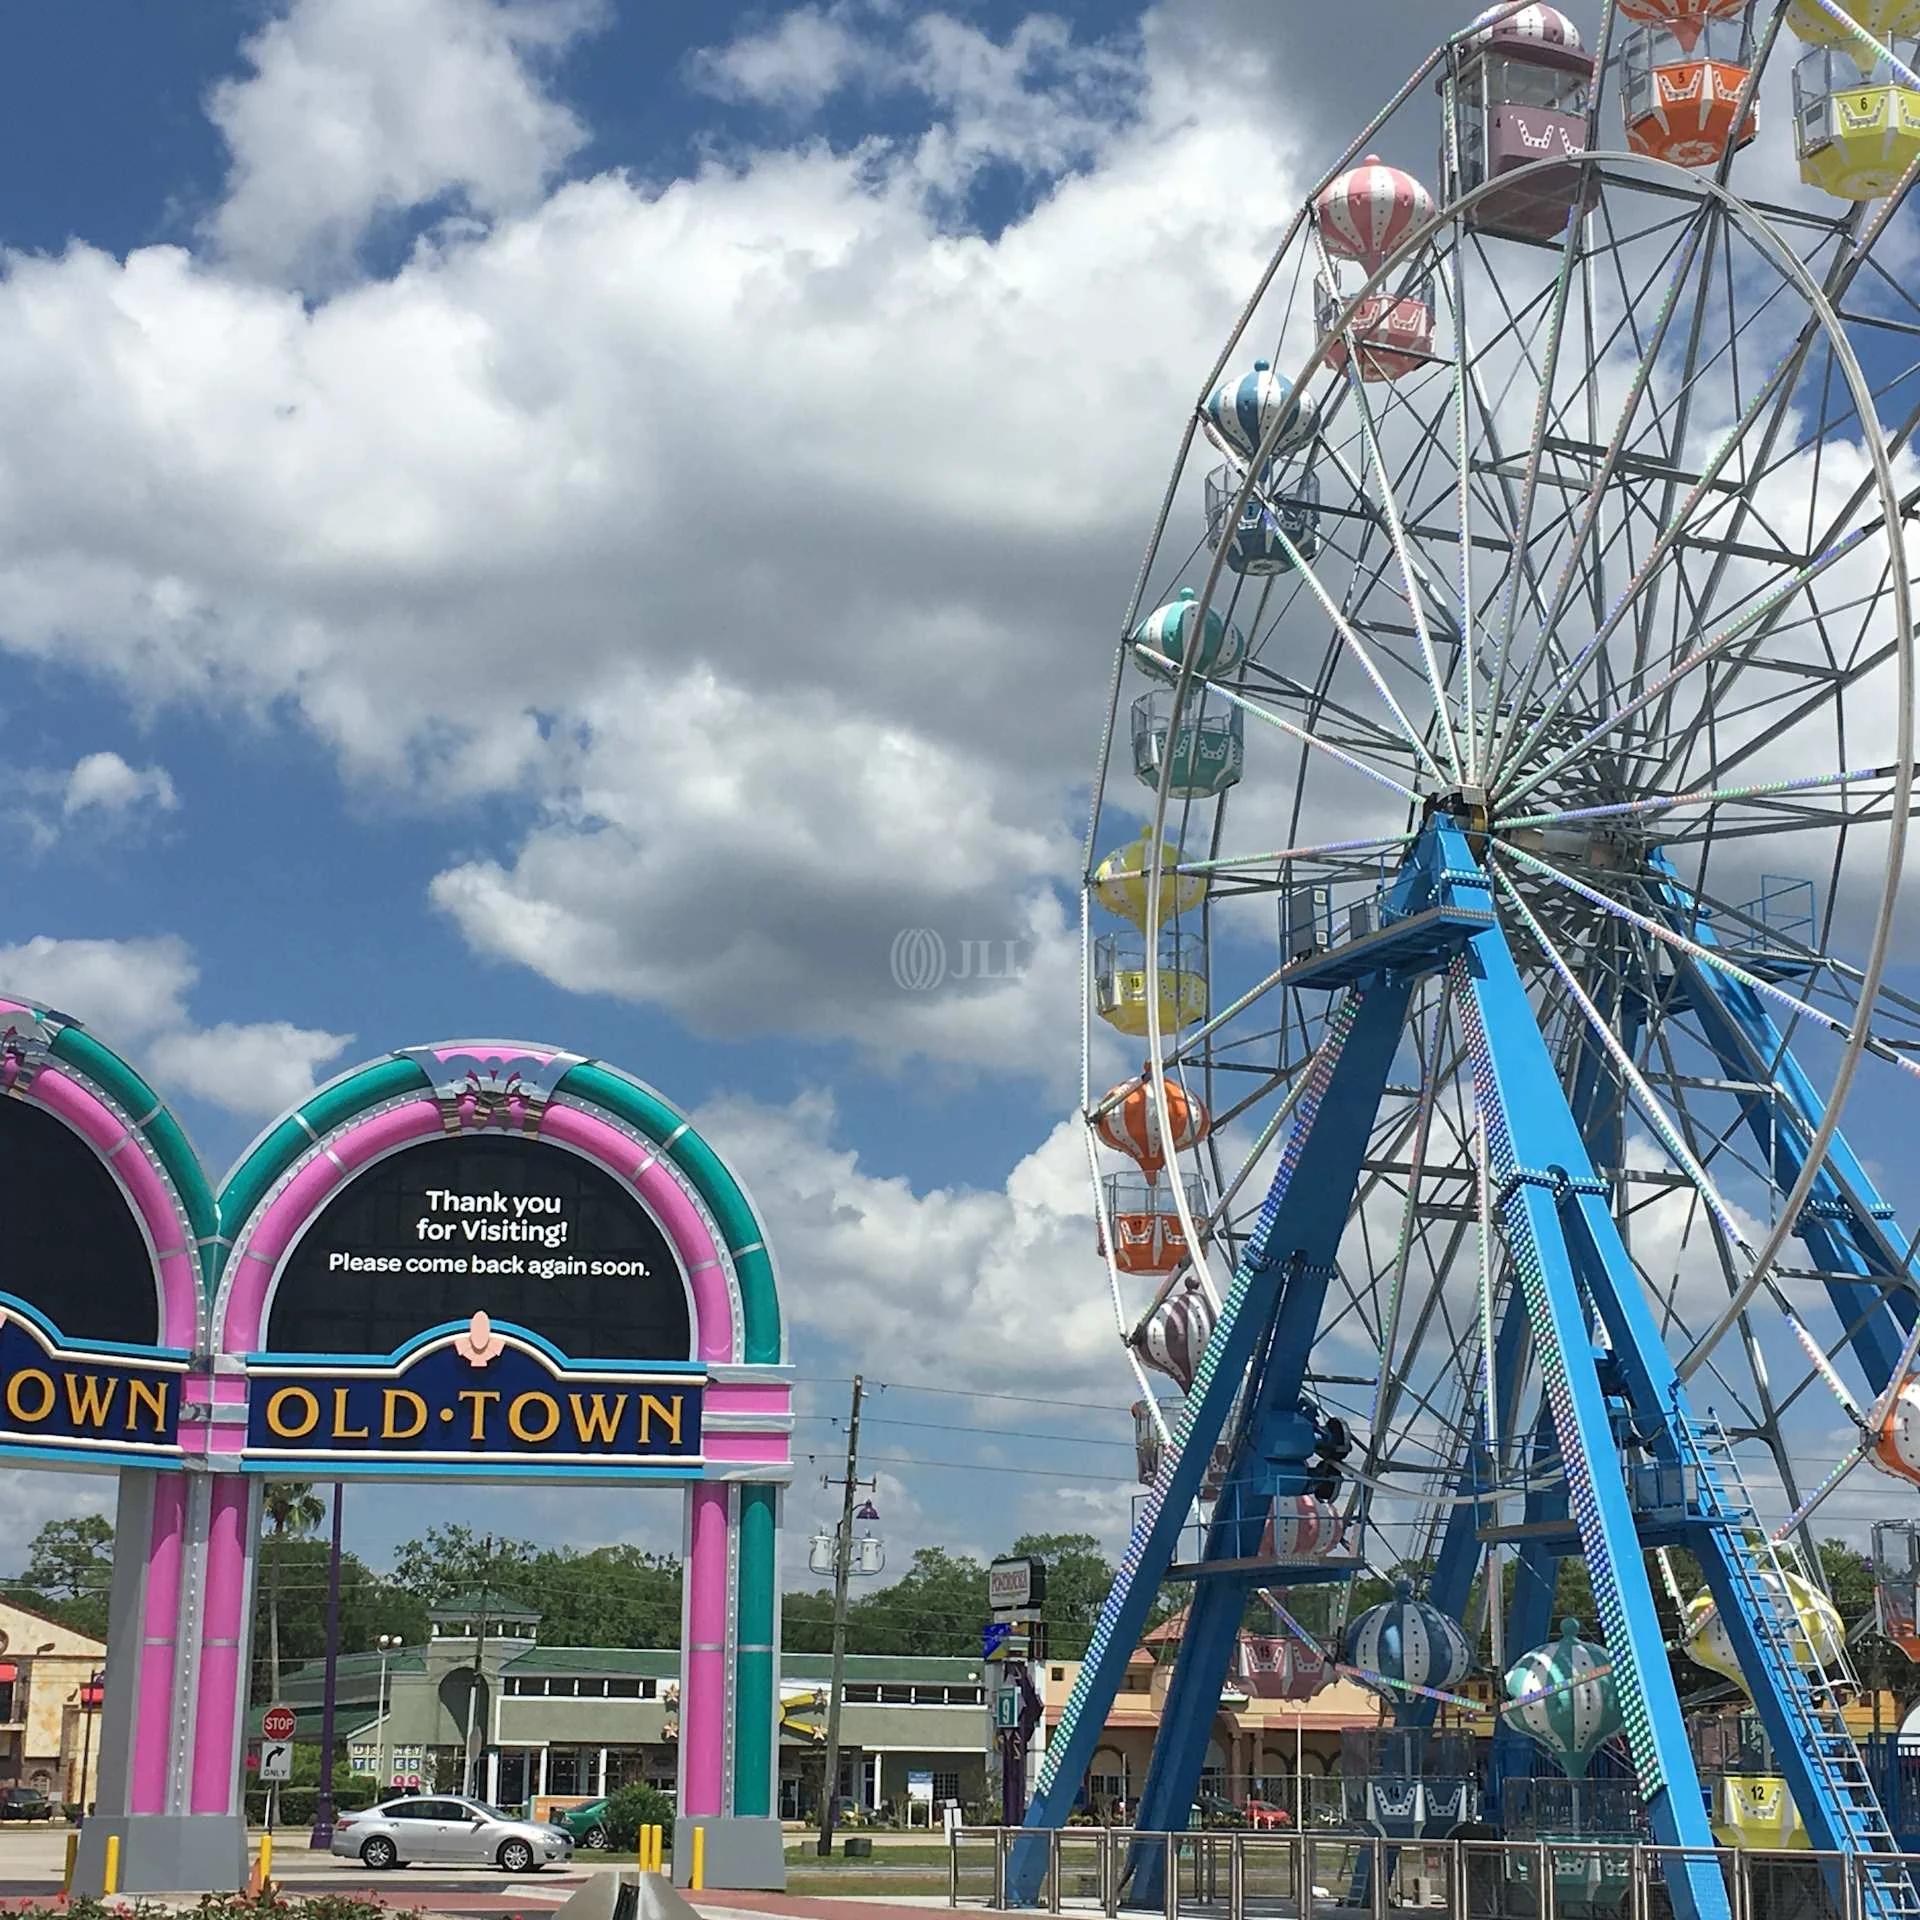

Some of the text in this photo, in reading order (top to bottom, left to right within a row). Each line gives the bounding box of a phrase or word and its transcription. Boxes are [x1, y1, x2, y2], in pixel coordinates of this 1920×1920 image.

[1678, 71, 1685, 84] 5
[1860, 96, 1868, 111] 6
[425, 1189, 562, 1218] Thank you
[415, 1217, 569, 1249] for Visiting!
[328, 1252, 651, 1279] Please come back again soon.
[1002, 1698, 1011, 1724] 9
[265, 1716, 294, 1730] STOP
[263, 1769, 287, 1777] ONLY
[1751, 1785, 1765, 1800] 12
